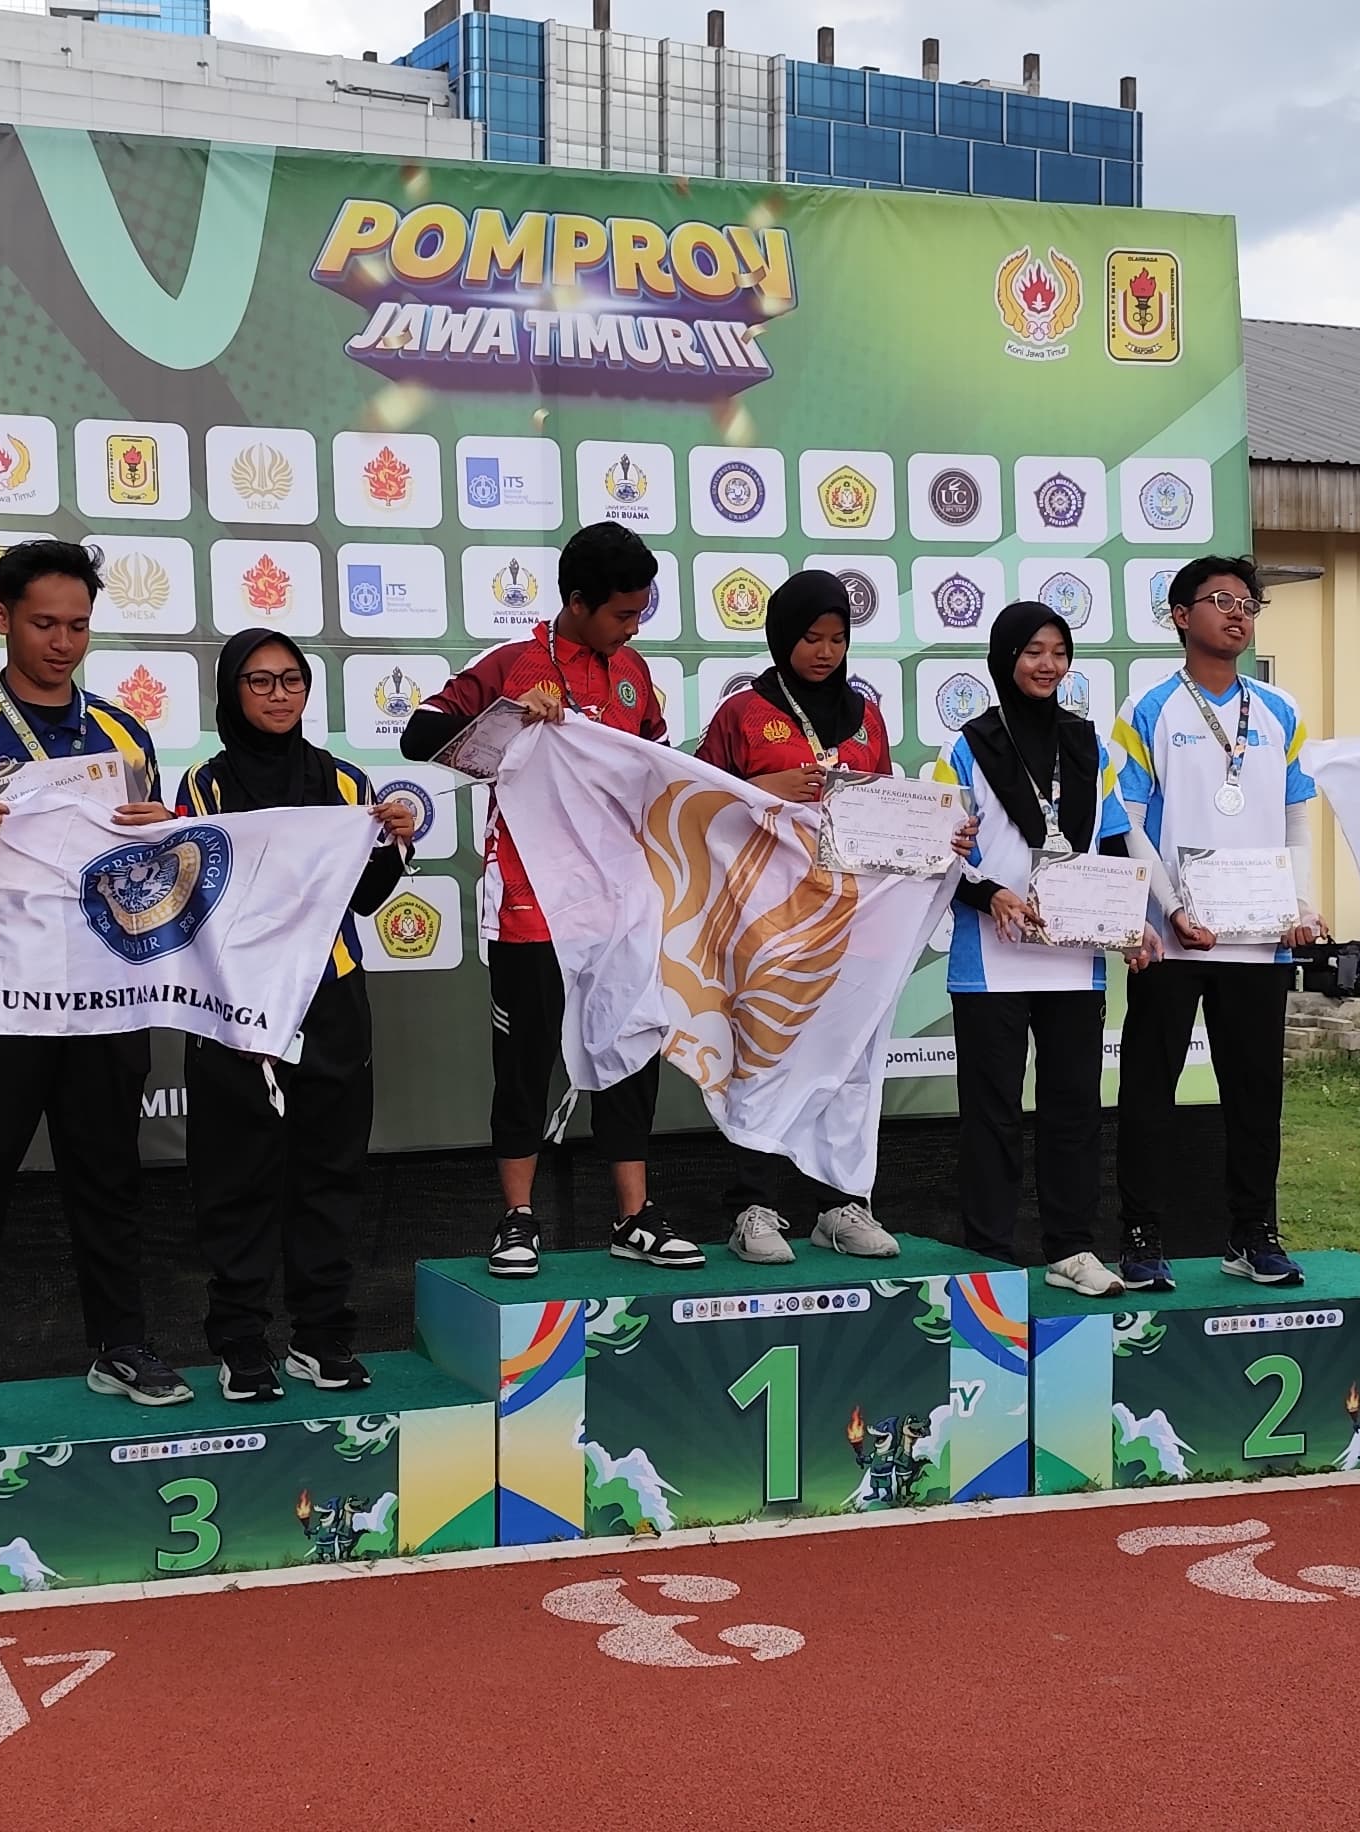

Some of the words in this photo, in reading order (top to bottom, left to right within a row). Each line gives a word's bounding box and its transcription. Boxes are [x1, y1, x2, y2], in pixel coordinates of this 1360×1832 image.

[314, 200, 794, 300] POMPROV
[351, 303, 516, 357] JAWA
[526, 312, 705, 369] TIMUR
[1007, 344, 1024, 356] Koni
[1025, 349, 1045, 358] Jawa
[1047, 347, 1066, 357] Timur
[13, 490, 37, 501] Timur
[941, 490, 967, 505] UC
[246, 500, 280, 511] UNESA
[606, 511, 620, 519] ADI
[621, 512, 650, 520] BUANA
[849, 591, 865, 605] C
[122, 611, 156, 620] UNESA
[493, 616, 508, 624] ADI
[852, 785, 880, 795] PIAGAM
[1244, 1354, 1305, 1460] 2
[727, 1344, 801, 1501] 1
[156, 1477, 221, 1571] 3
[541, 1573, 806, 1668] 3
